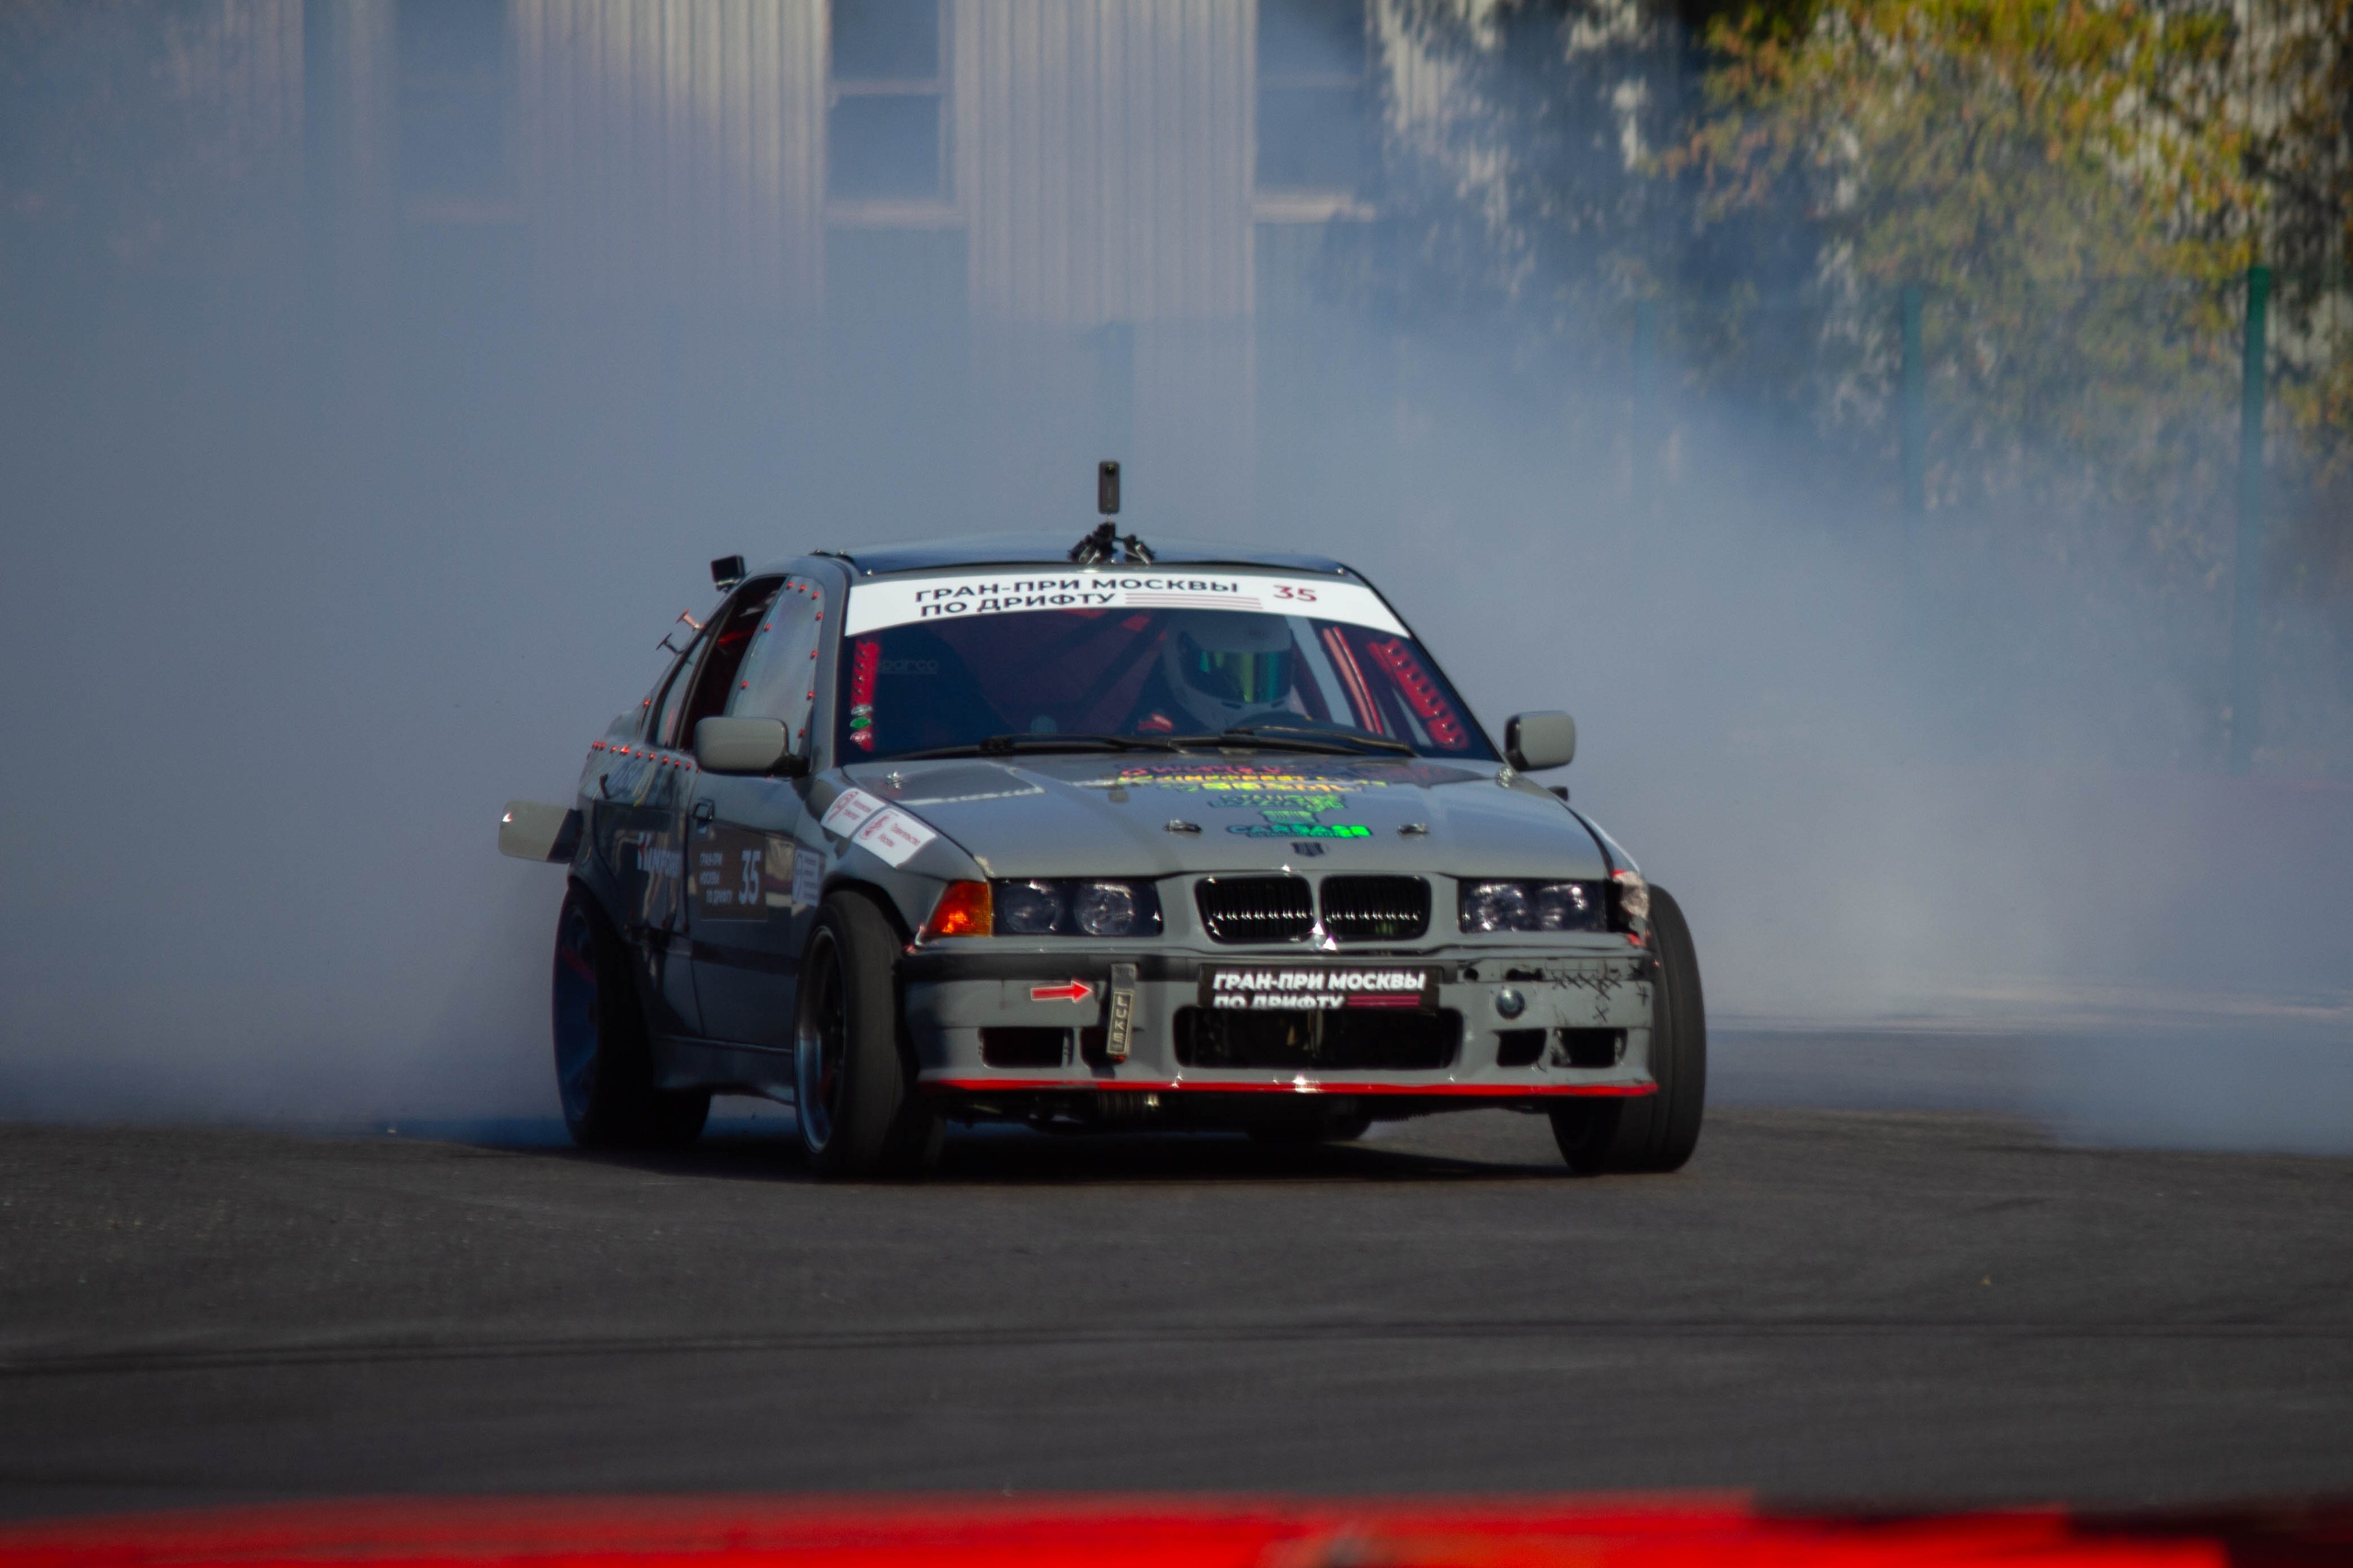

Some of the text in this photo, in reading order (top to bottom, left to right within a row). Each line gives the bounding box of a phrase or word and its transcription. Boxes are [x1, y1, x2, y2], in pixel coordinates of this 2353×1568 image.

[915, 578, 1238, 603] ГРАН-ПРИ МОСКВЫ
[1273, 585, 1317, 602] 35
[921, 593, 1115, 618] ПО ДРИФТУ
[738, 849, 761, 905] 35
[1212, 971, 1426, 991] ГРАН-ПРИ МОСКВЫ
[1213, 994, 1346, 1009] ПО ДРИФТУ
